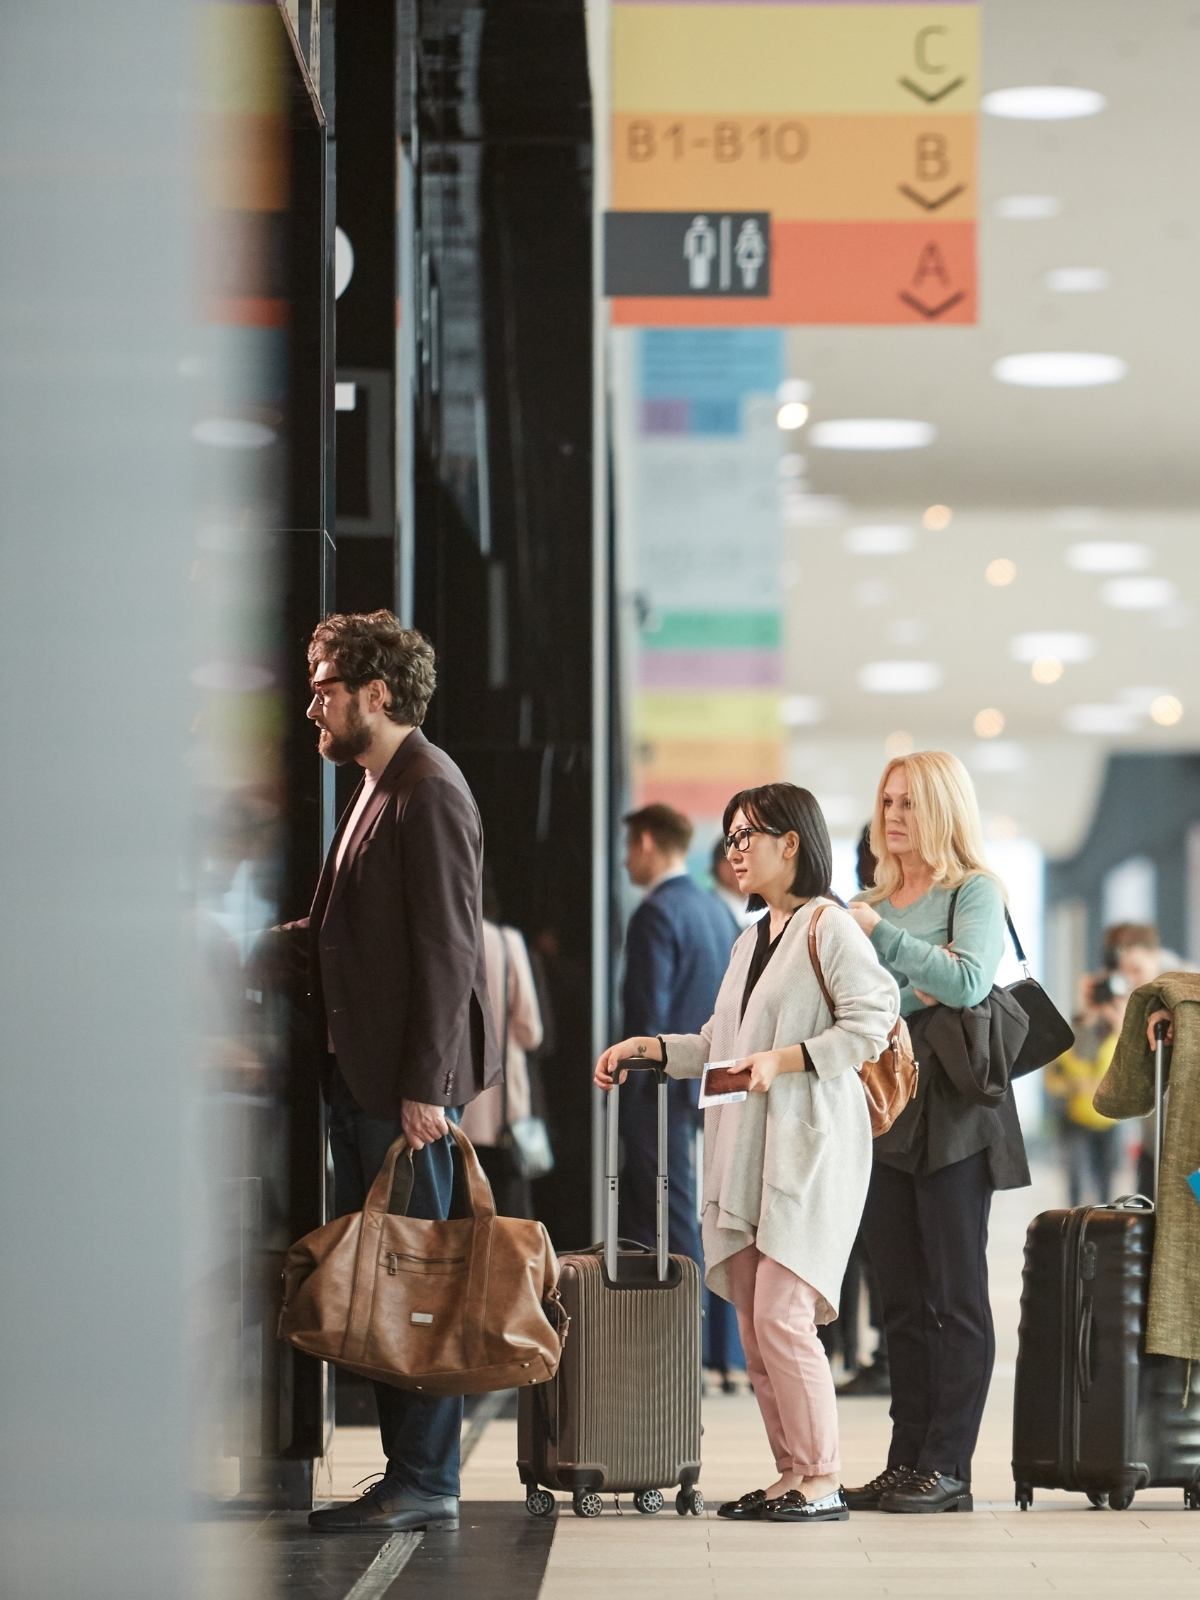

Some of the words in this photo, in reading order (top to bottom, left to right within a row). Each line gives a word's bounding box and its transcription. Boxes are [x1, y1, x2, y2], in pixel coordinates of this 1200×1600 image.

[915, 26, 947, 74] C
[627, 122, 808, 163] B1-B10
[916, 133, 949, 181] B
[913, 241, 949, 287] A
